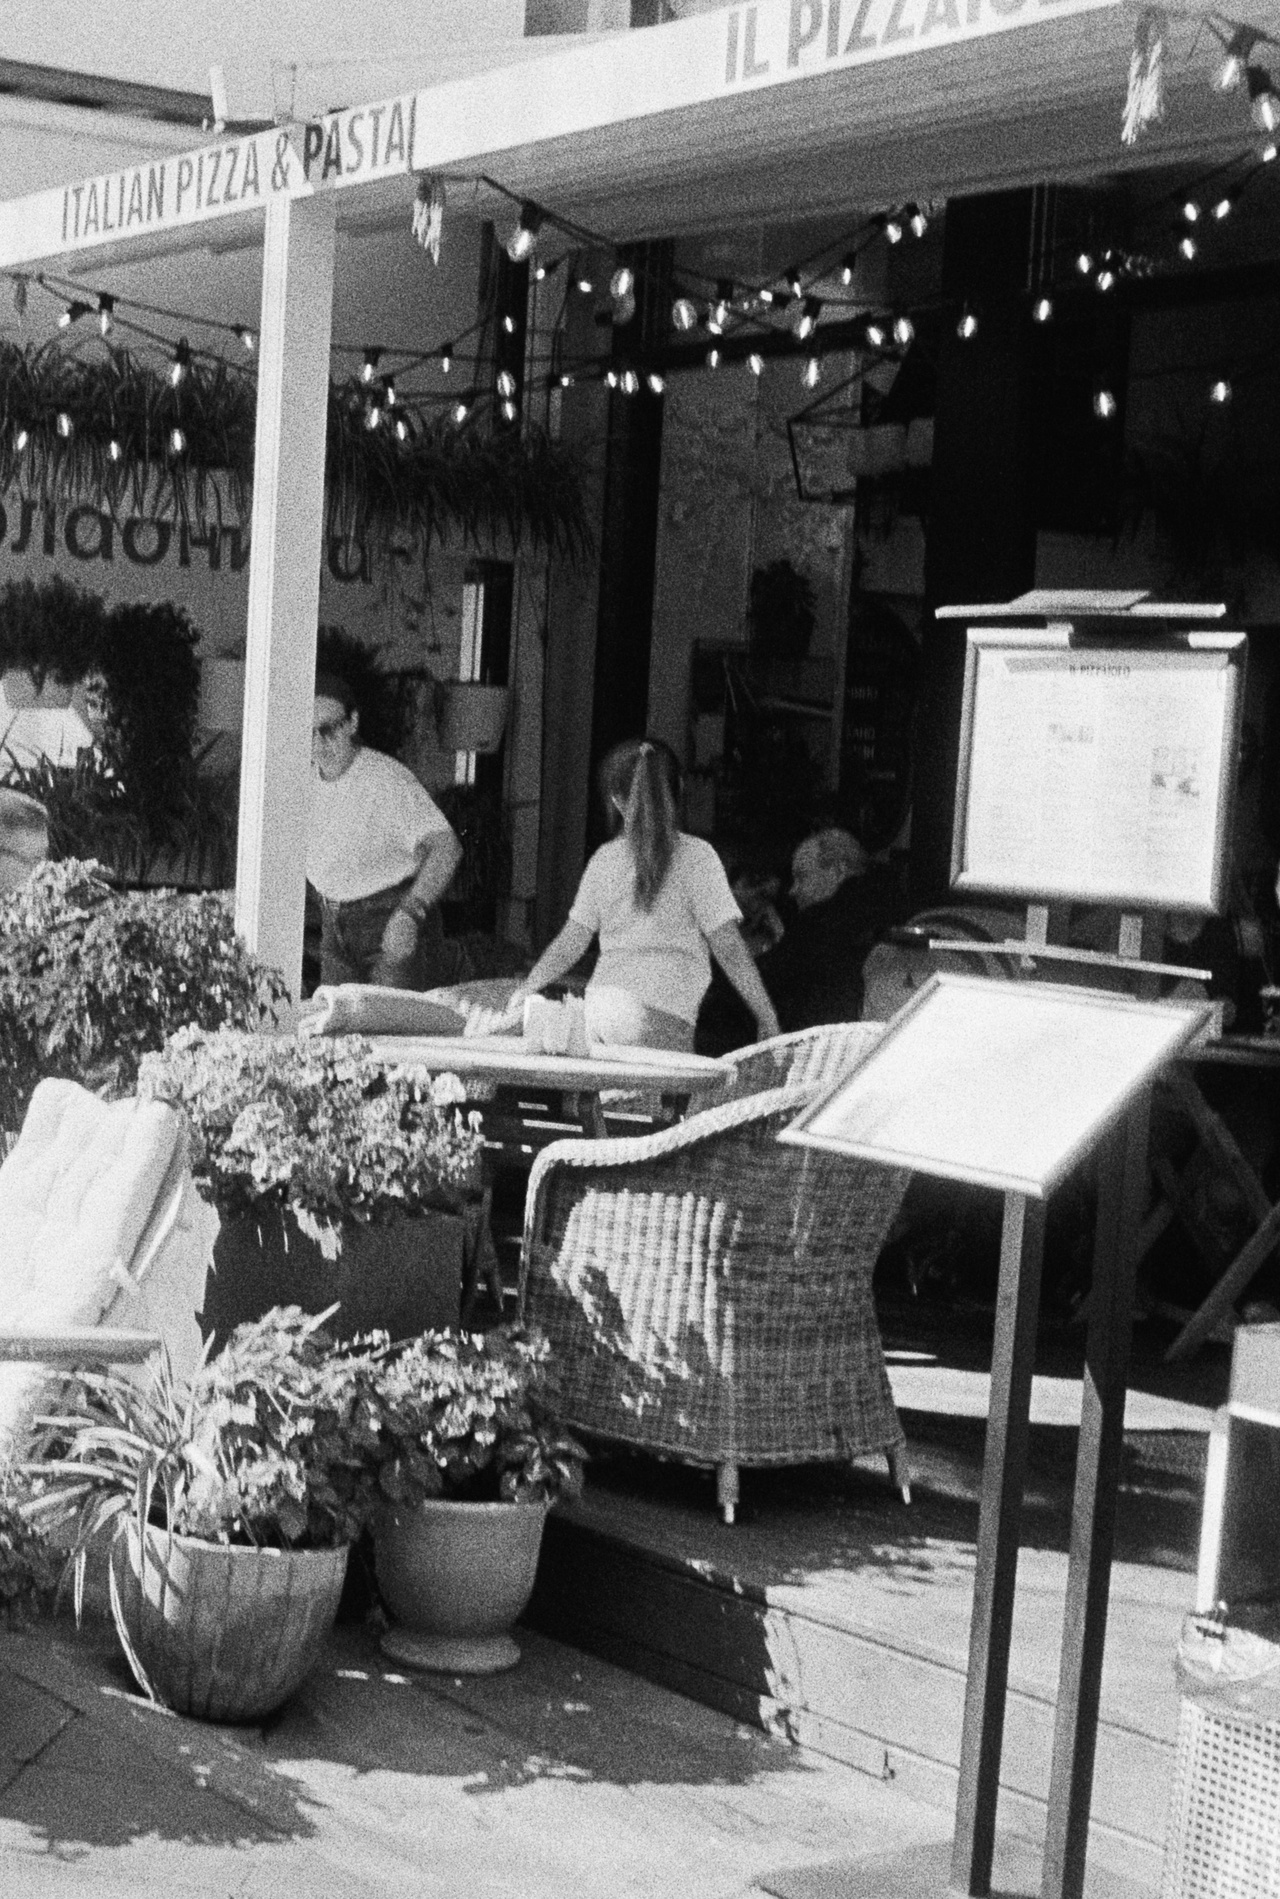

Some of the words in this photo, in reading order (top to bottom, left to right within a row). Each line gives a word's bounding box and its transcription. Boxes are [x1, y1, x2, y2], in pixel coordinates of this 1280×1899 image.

[725, 6, 770, 84] IL
[61, 164, 166, 242] ITALIAN
[176, 141, 261, 214] PIZZA
[270, 131, 292, 192] &
[303, 101, 407, 182] PASTA
